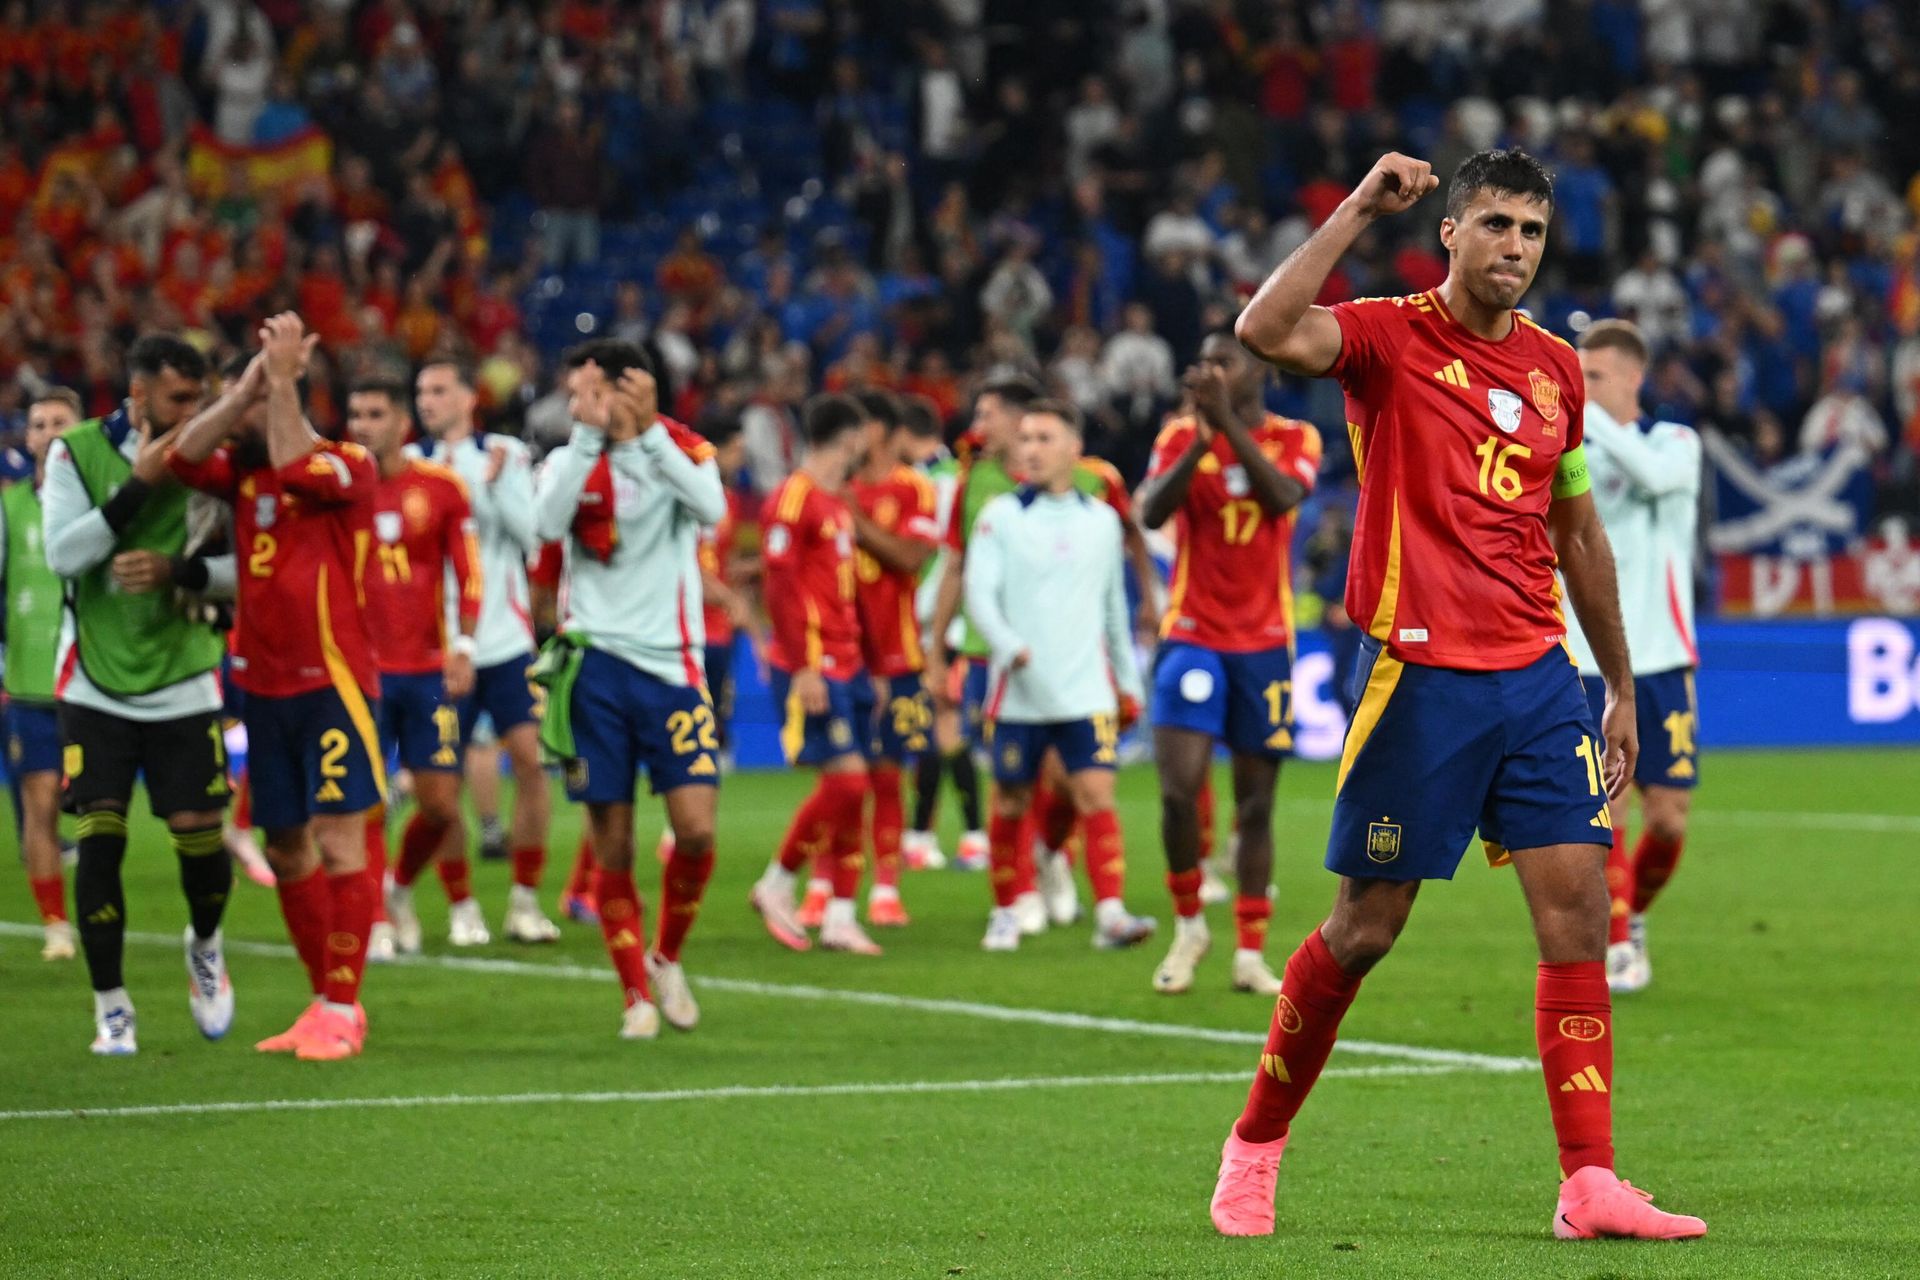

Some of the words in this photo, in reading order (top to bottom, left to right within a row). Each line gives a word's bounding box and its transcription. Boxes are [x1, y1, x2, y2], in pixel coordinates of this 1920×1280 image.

[1475, 435, 1531, 502] 16
[1220, 499, 1262, 545] 17
[249, 531, 277, 578] 2
[1847, 616, 1920, 723] B
[319, 727, 350, 778] 2
[665, 704, 719, 755] 22
